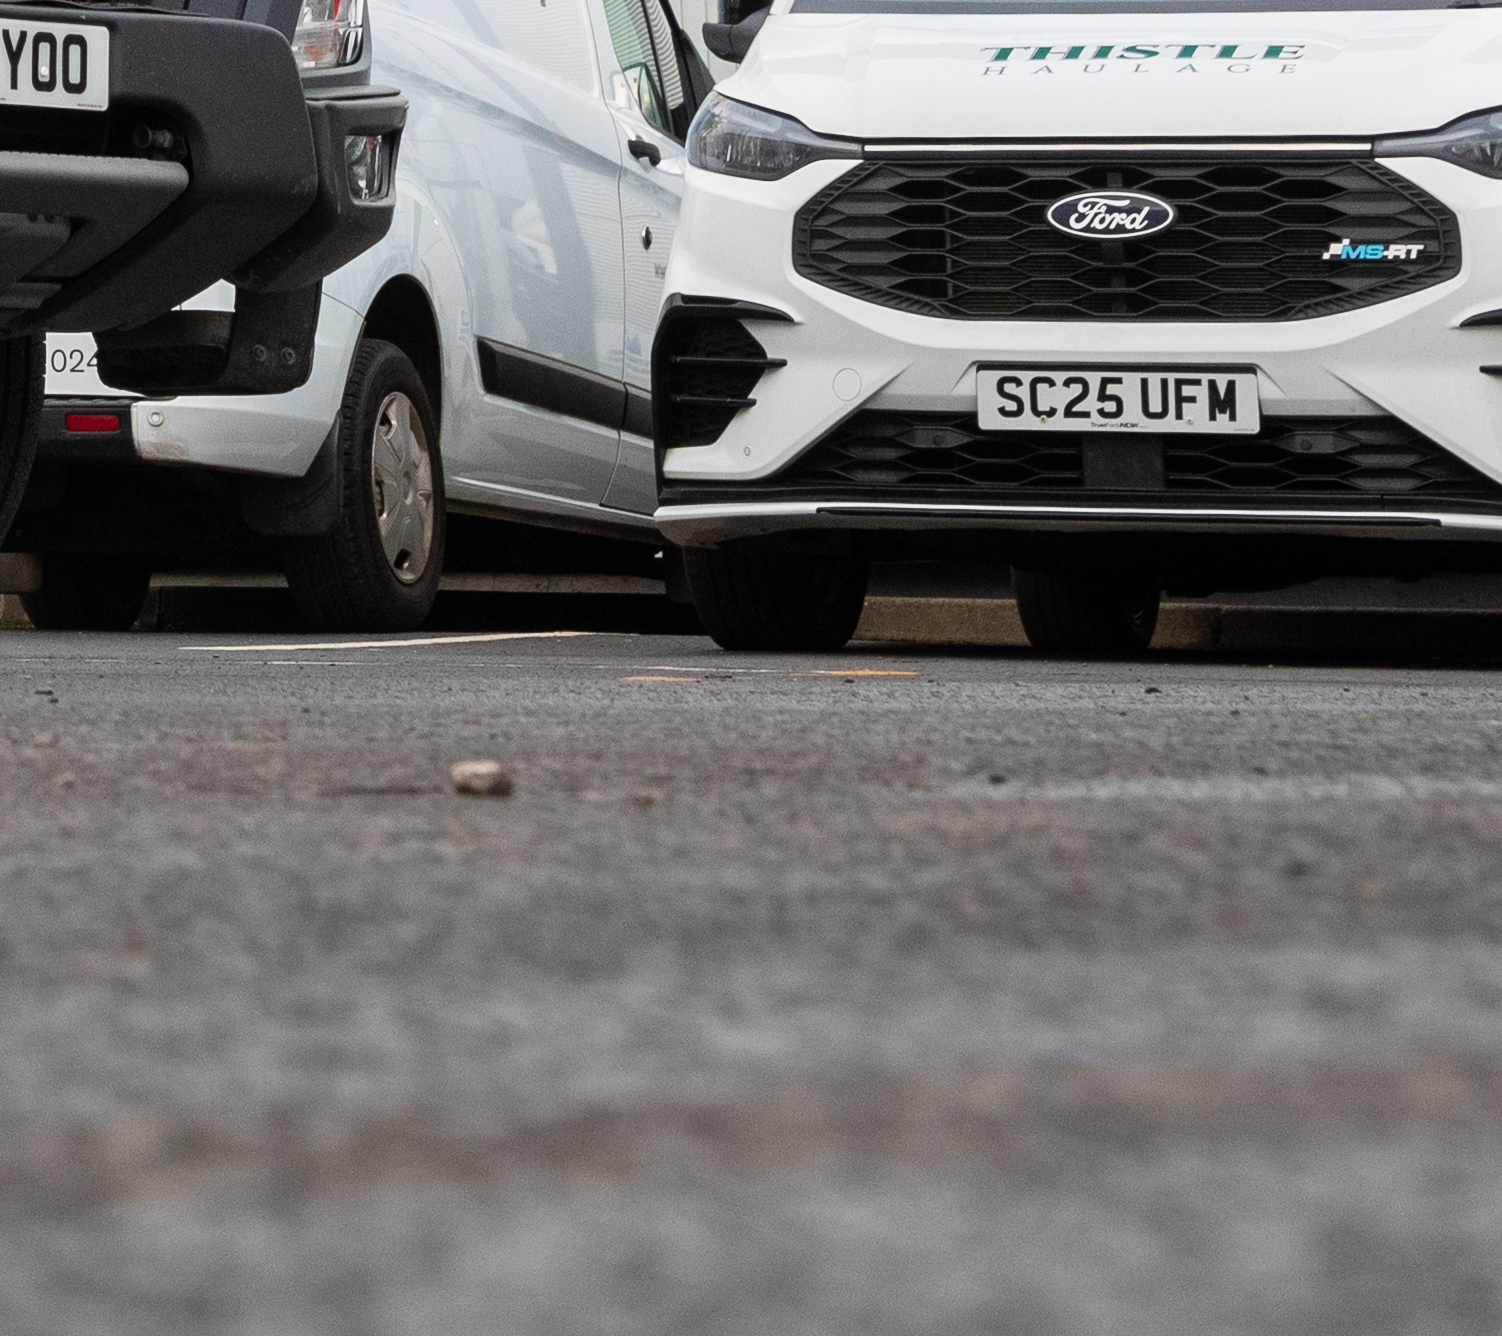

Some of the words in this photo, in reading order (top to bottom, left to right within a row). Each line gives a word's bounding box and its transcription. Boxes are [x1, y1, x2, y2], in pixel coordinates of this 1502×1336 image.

[2, 28, 88, 95] YOO
[979, 44, 1306, 62] THISTLE
[981, 63, 1298, 76] HAULAGE
[1069, 196, 1151, 230] Ford
[1339, 243, 1425, 260] MS-RT
[996, 375, 1124, 420] SC25
[1140, 377, 1237, 422] UFM
